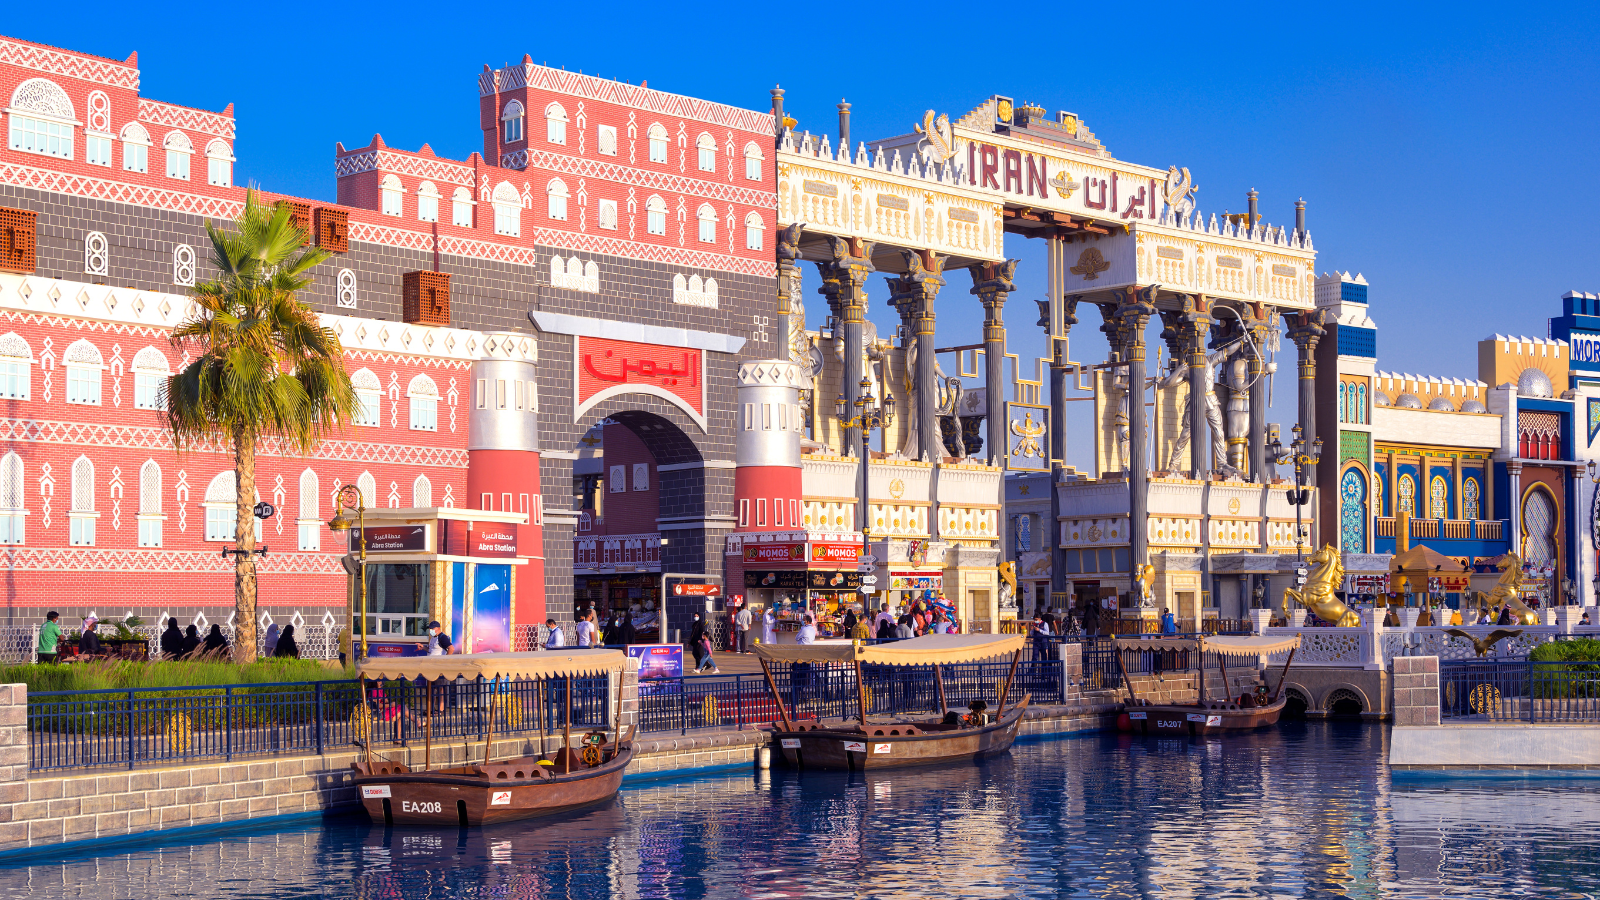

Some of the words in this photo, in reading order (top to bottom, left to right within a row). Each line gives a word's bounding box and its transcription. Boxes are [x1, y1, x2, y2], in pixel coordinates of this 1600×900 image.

[967, 141, 1049, 199] IRAN
[1083, 171, 1157, 220] ايران
[1571, 338, 1600, 362] MOR
[582, 349, 698, 387] اليمن
[498, 532, 514, 540] محطة
[494, 544, 516, 552] Station
[758, 548, 789, 558] MOMOS
[827, 548, 856, 558] MOMOS
[402, 800, 442, 813] EA208
